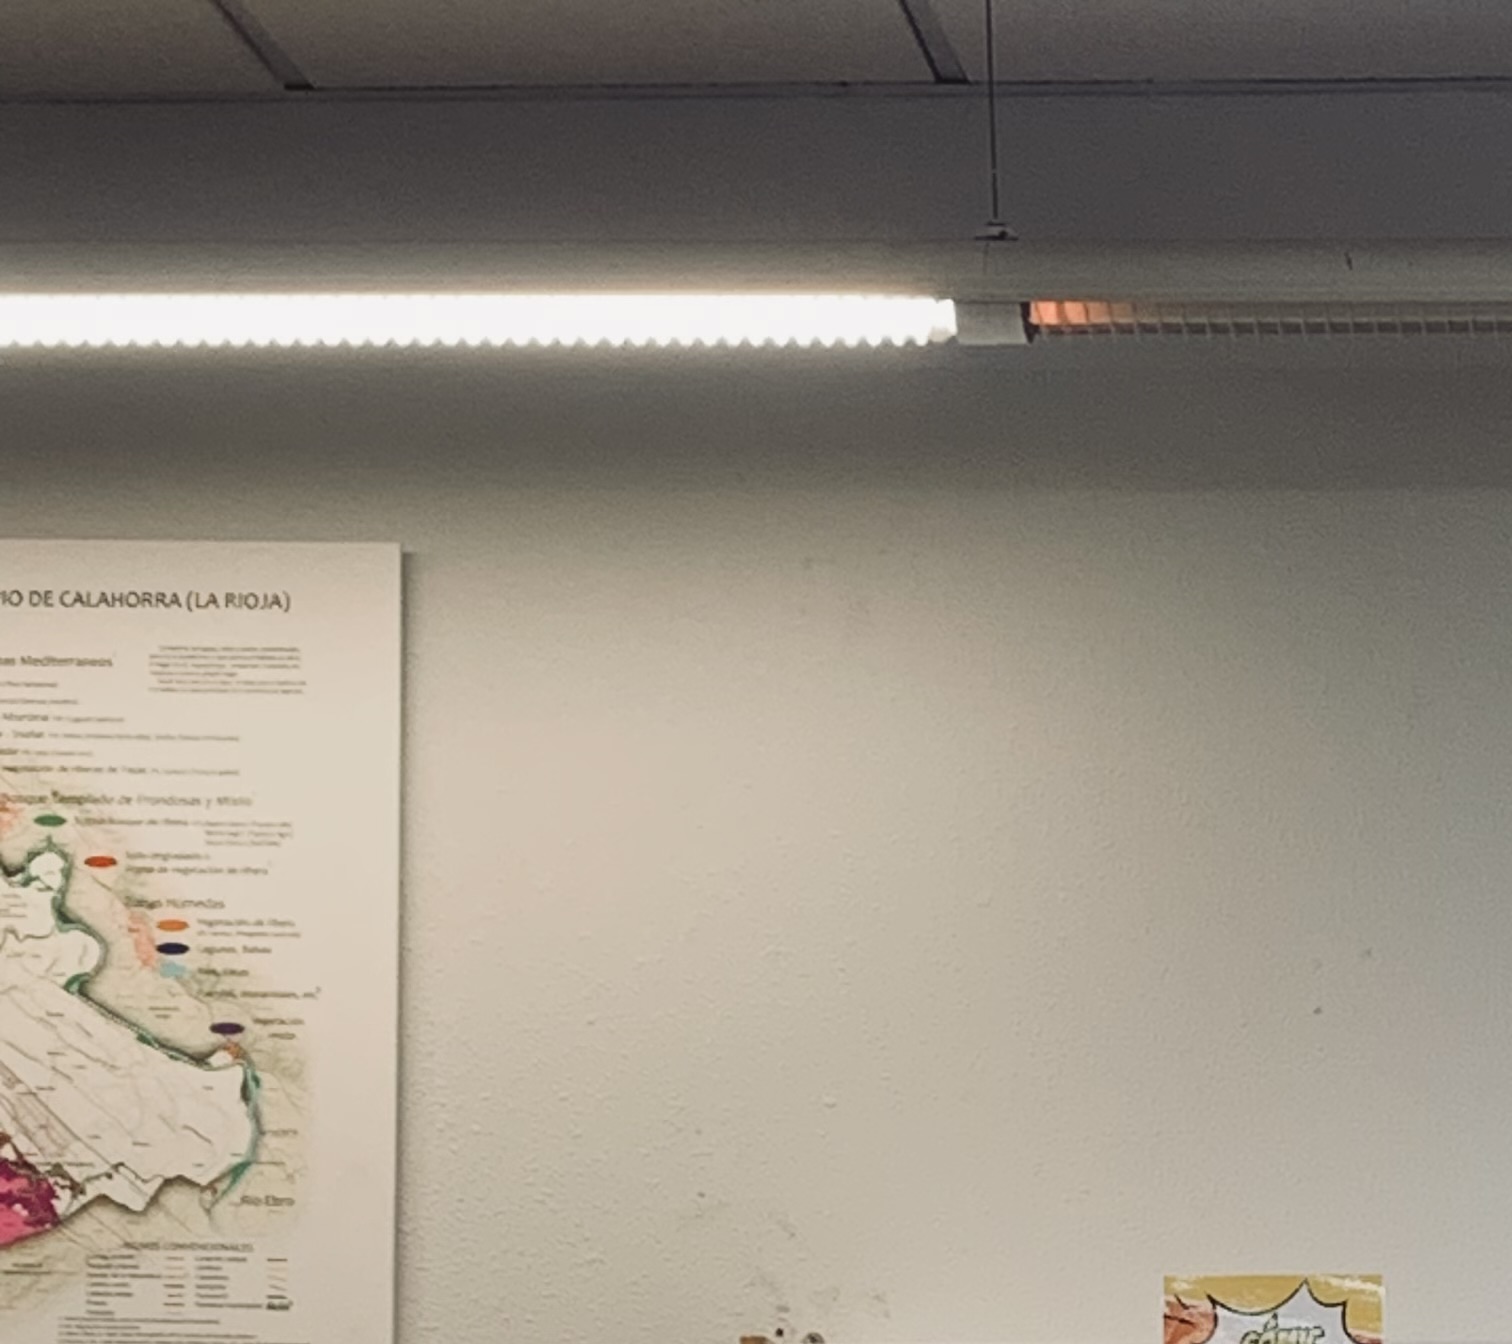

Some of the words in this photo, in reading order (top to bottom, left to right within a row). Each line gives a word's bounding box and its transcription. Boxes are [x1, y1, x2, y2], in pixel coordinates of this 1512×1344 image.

[29, 590, 53, 608] DE
[60, 590, 182, 609] CALAHORRA
[186, 590, 219, 613] (LA
[225, 591, 291, 613] RIOJA)
